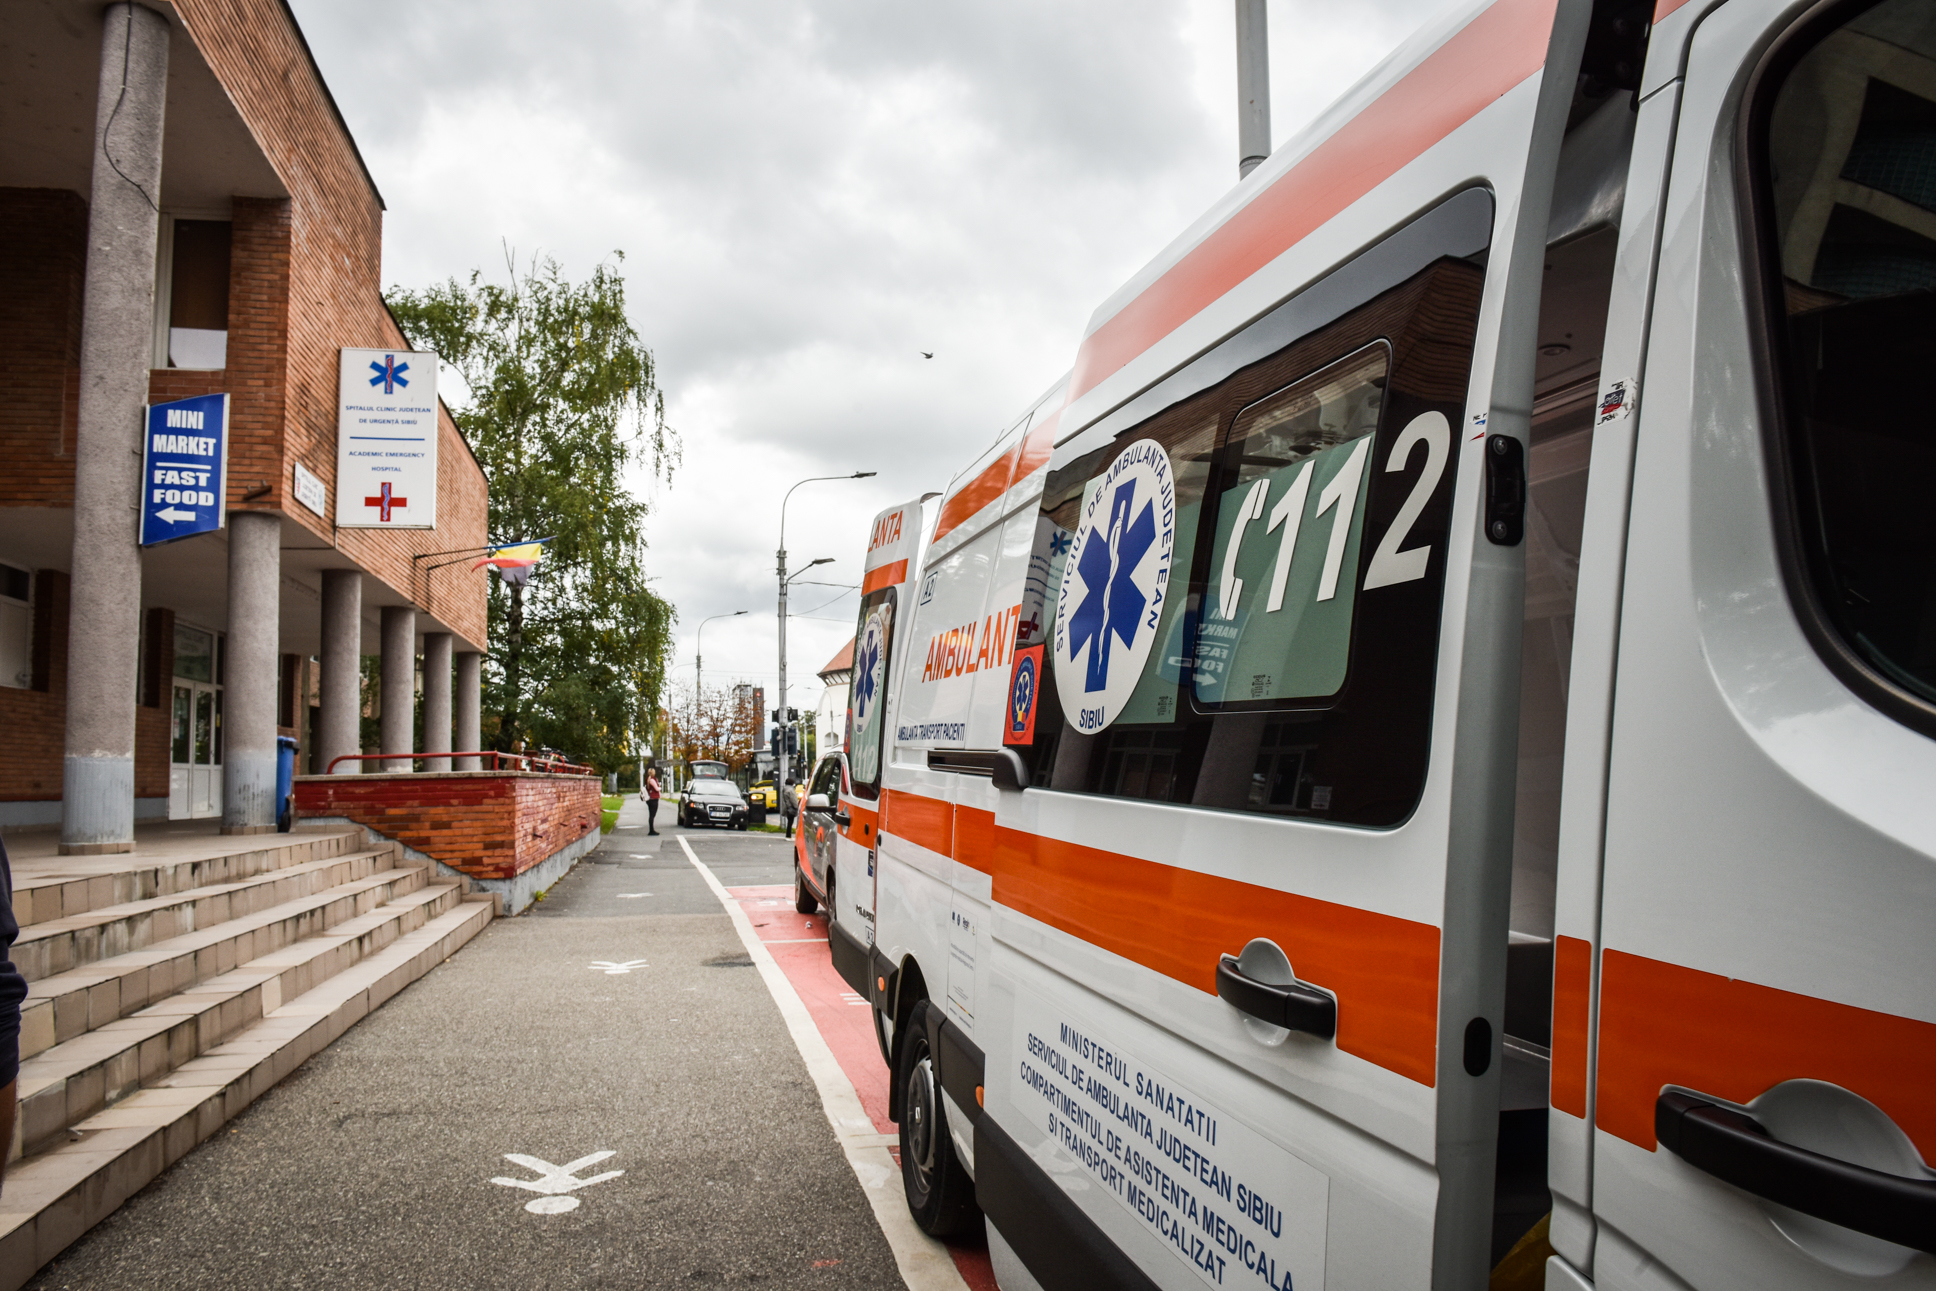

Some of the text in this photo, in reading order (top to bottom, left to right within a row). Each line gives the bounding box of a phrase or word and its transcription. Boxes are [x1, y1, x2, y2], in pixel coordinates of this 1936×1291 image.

[153, 434, 216, 456] MARKET
[167, 409, 204, 430] MINI
[153, 489, 214, 506] FOOD
[154, 470, 211, 486] FAST
[1266, 411, 1450, 613] 112
[1056, 445, 1173, 652] SERVICIUL DE AMBULANTA JUDETEAN
[898, 723, 965, 741] AMBULANTA TRANSPORT PACIENTI
[1079, 706, 1105, 730] SIBIU
[1060, 1022, 1217, 1146] MINISTERUL SANATATII
[1028, 1033, 1282, 1239] SERVICIUL DE AMBULANTA JUDETEAN SIBIU
[1020, 1061, 1294, 1291] COMPARTIMENTUL DE ASISTENTA MEDICALA
[1048, 1112, 1226, 1285] SI TRANSPORT MEDICALIZAT
